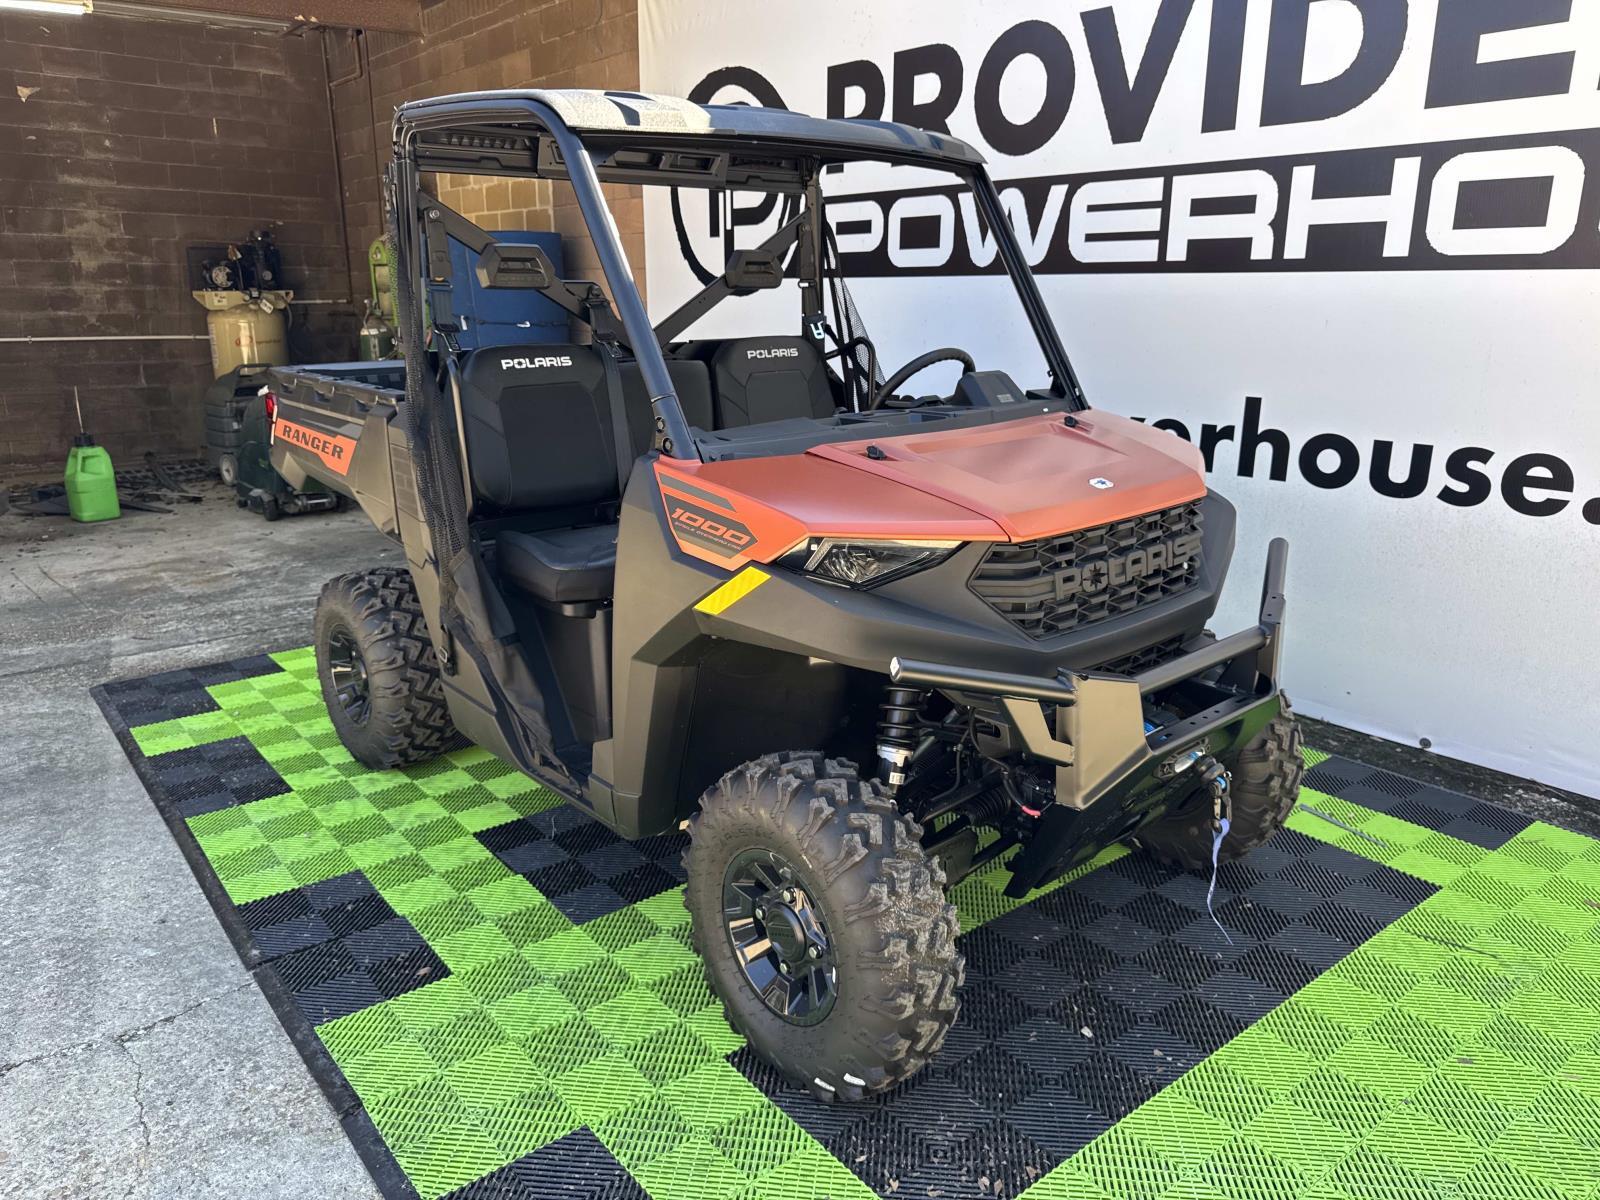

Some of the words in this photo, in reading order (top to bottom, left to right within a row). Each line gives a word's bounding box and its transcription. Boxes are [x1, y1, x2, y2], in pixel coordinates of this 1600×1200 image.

[826, 0, 1600, 174] PROVIDE
[817, 145, 1600, 268] POWERHO
[500, 356, 573, 370] POLARIS
[746, 348, 799, 360] POLARIS
[282, 425, 344, 460] RANGER
[1130, 396, 1600, 525] rhouse.
[671, 507, 751, 546] 1000
[1055, 535, 1194, 601] POLARIS
